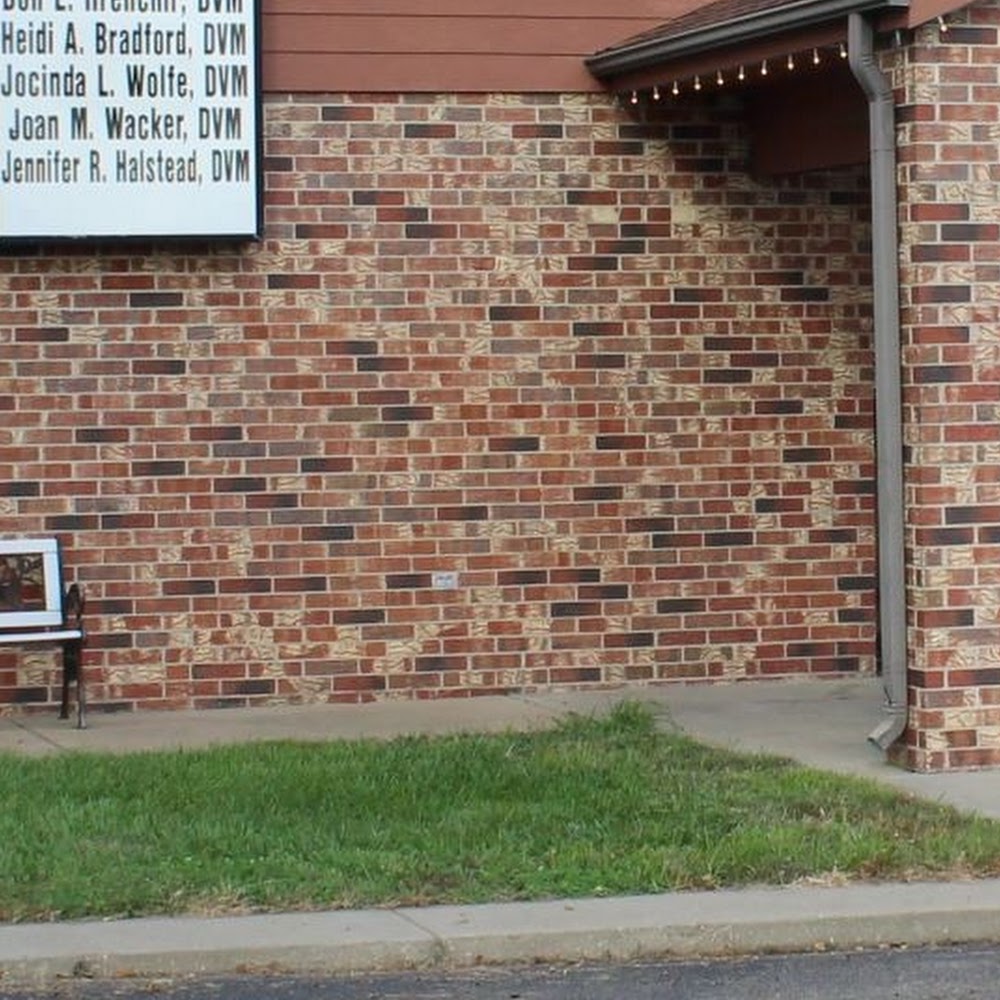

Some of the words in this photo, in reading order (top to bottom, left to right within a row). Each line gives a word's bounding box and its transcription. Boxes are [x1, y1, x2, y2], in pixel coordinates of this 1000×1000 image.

[1, 21, 53, 55] Heidi
[64, 22, 84, 55] A.
[95, 22, 193, 59] Bradford,
[204, 23, 247, 56] DVM
[1, 64, 86, 98] Jocinda
[98, 65, 115, 98] L.
[126, 65, 194, 102] Wolfe,
[205, 65, 248, 98] DVM
[9, 107, 59, 140] Joan
[70, 107, 94, 140] M.
[105, 107, 188, 143] Wacker,
[199, 108, 242, 140] DVM
[1, 150, 80, 184] Jennifer
[89, 151, 107, 184] R.
[116, 150, 203, 187] Halstead,
[212, 150, 250, 184] DVM
